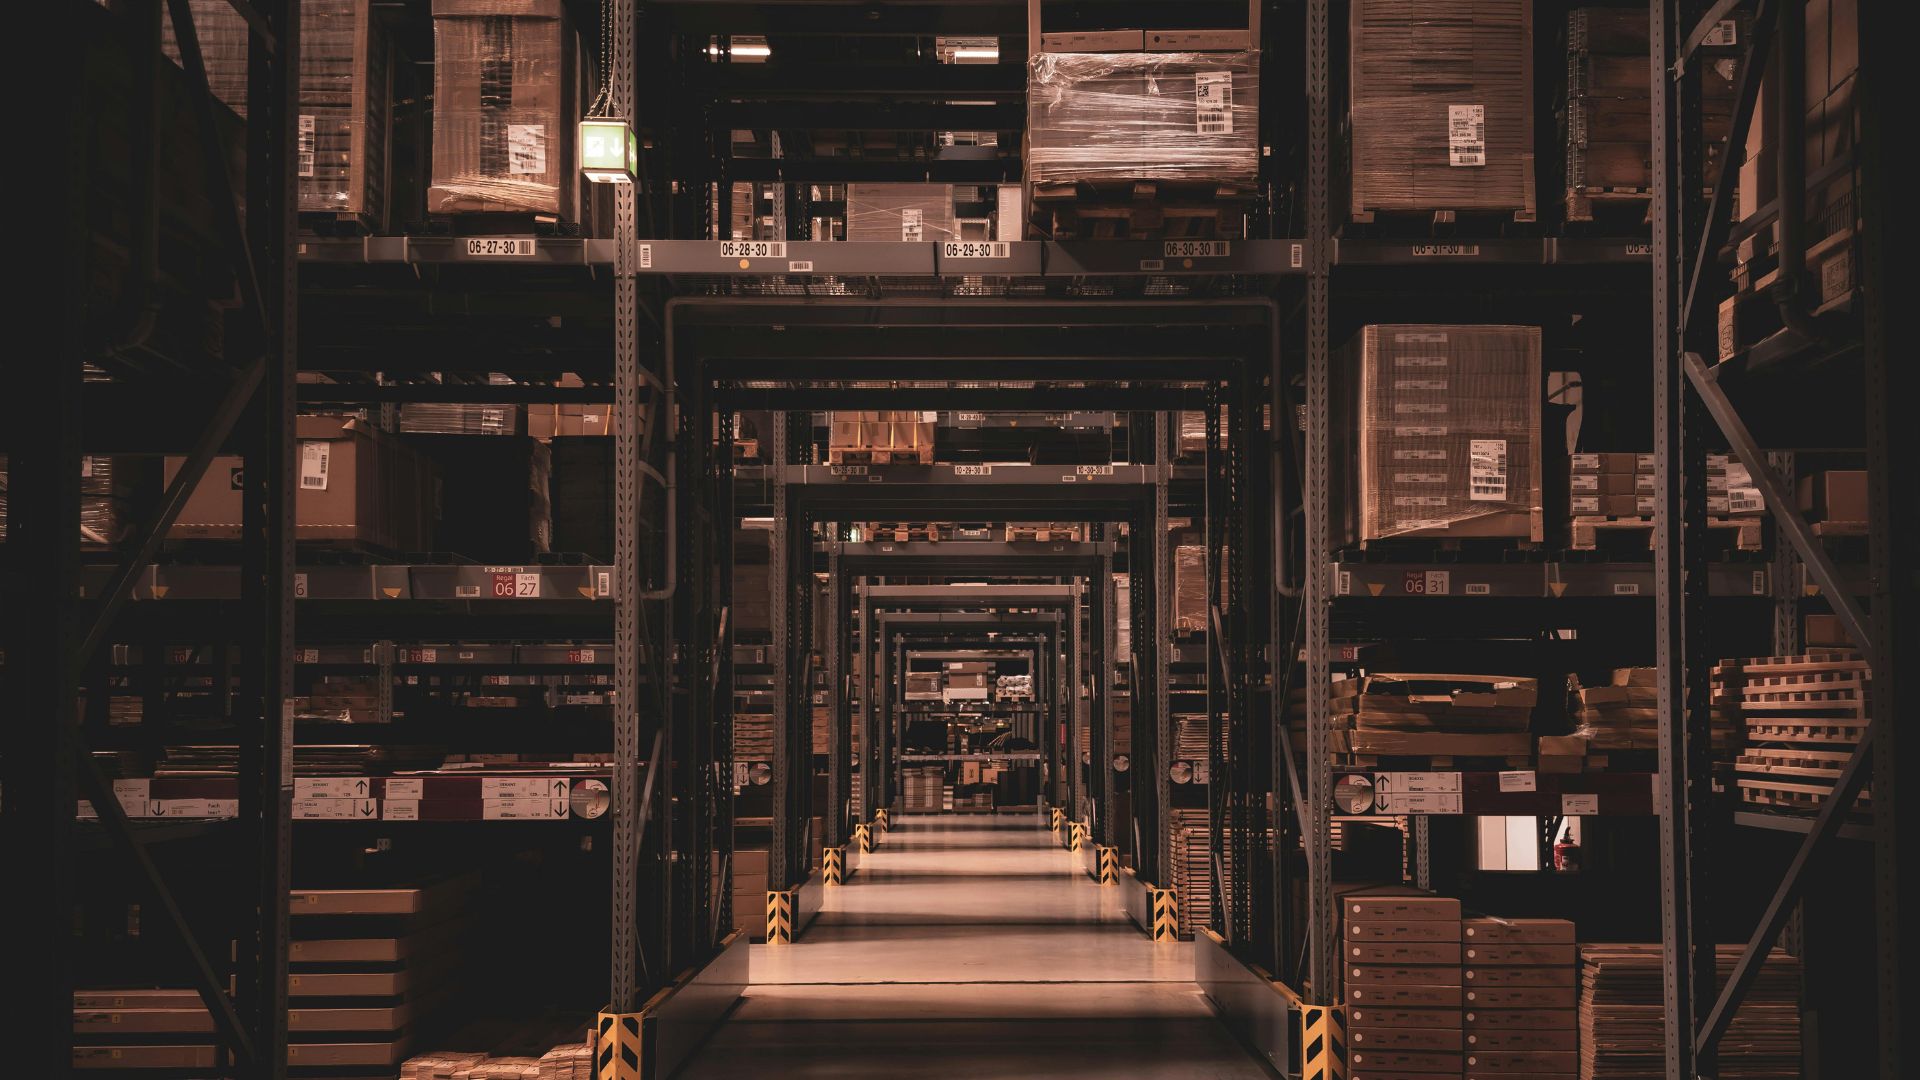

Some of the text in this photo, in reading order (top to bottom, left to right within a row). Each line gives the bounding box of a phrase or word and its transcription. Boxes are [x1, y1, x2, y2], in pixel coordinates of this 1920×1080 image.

[469, 240, 515, 254] 06-27-30
[722, 242, 767, 256] 06-28-30
[946, 243, 991, 256] 06-29-30
[1166, 243, 1211, 256] 06-30-30
[956, 466, 981, 474] 10-29-30
[496, 574, 513, 582] Regal
[296, 583, 304, 596] 6
[495, 582, 514, 596] 06
[519, 582, 537, 596] 27
[1405, 579, 1424, 593] 06
[1430, 580, 1445, 593] 31
[411, 654, 421, 662] 10
[424, 654, 434, 662] 25
[569, 654, 580, 662] 10
[582, 654, 593, 662] 26
[1343, 650, 1352, 659] 10
